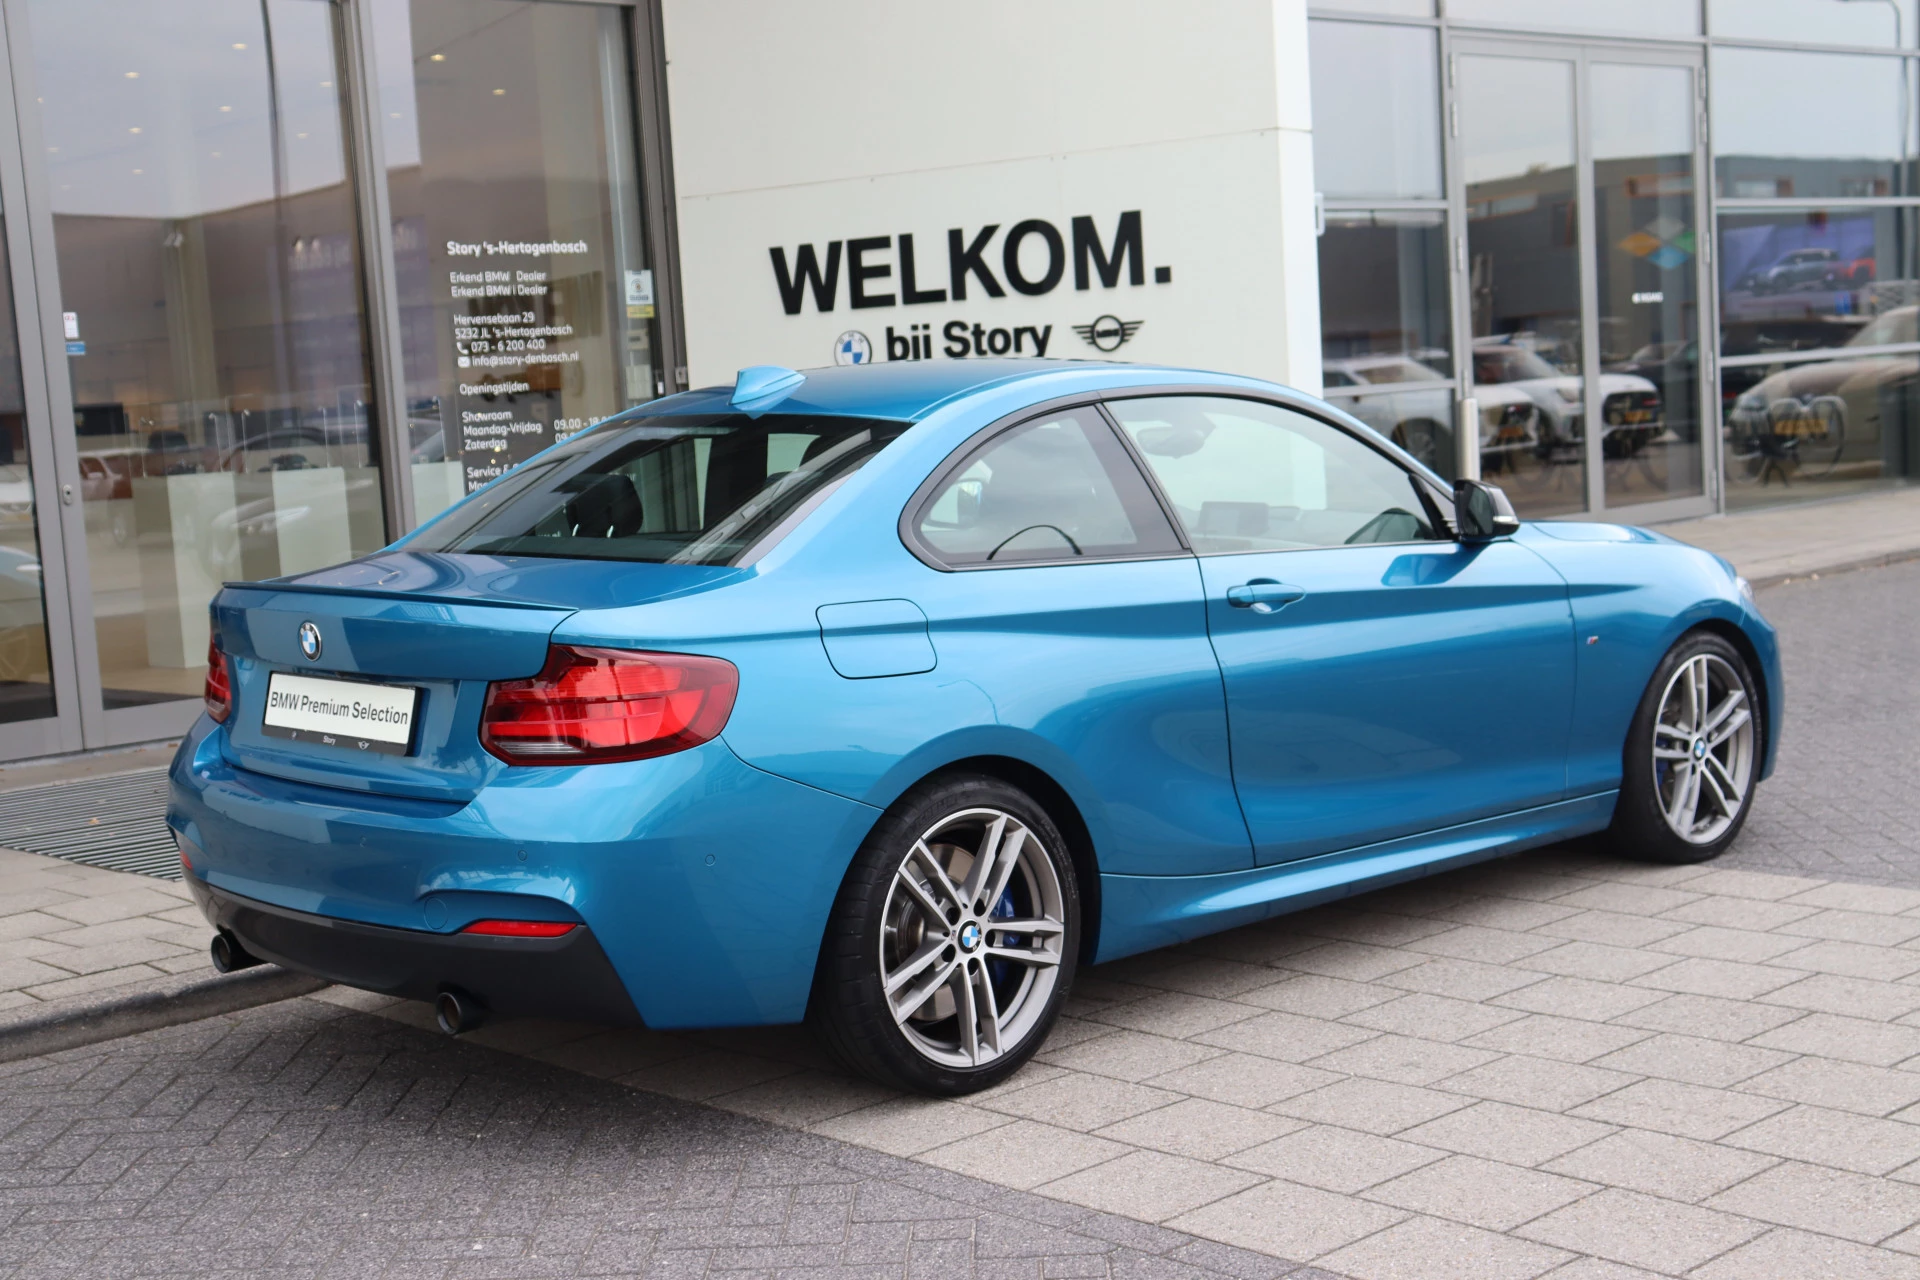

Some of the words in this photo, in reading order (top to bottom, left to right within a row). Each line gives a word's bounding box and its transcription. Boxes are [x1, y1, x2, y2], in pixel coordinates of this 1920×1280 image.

[447, 241, 481, 257] Story
[483, 240, 588, 257] 's-Hertogenbosch
[769, 210, 1171, 315] WELKOM.
[450, 271, 482, 284] Erkend
[485, 271, 510, 283] BMW
[516, 270, 547, 281] Dealer
[451, 285, 484, 297] Erkend
[486, 284, 511, 296] BMW
[518, 284, 548, 295] Dealer
[453, 313, 521, 325] Hervensebaan
[522, 312, 535, 323] 29
[455, 327, 478, 340] 5232
[480, 327, 491, 339] JL
[492, 324, 573, 338] 's-Hertogenbosch
[942, 320, 1053, 358] Story
[471, 341, 489, 353] 073
[497, 340, 505, 351] 6
[506, 340, 525, 351] 200
[526, 339, 546, 350] 400
[472, 351, 579, 367] info@story-denbosch.nl
[460, 382, 529, 396] Openingstijden
[462, 411, 512, 423] Showroom
[464, 422, 543, 437] Maandag-Vrijdag
[554, 418, 581, 431] 09.00
[465, 438, 507, 451] Zaterdag
[467, 465, 501, 479] Service
[270, 691, 300, 709] BMW
[301, 695, 350, 717] Premium
[351, 701, 408, 725] Selection
[323, 735, 336, 746] Story
